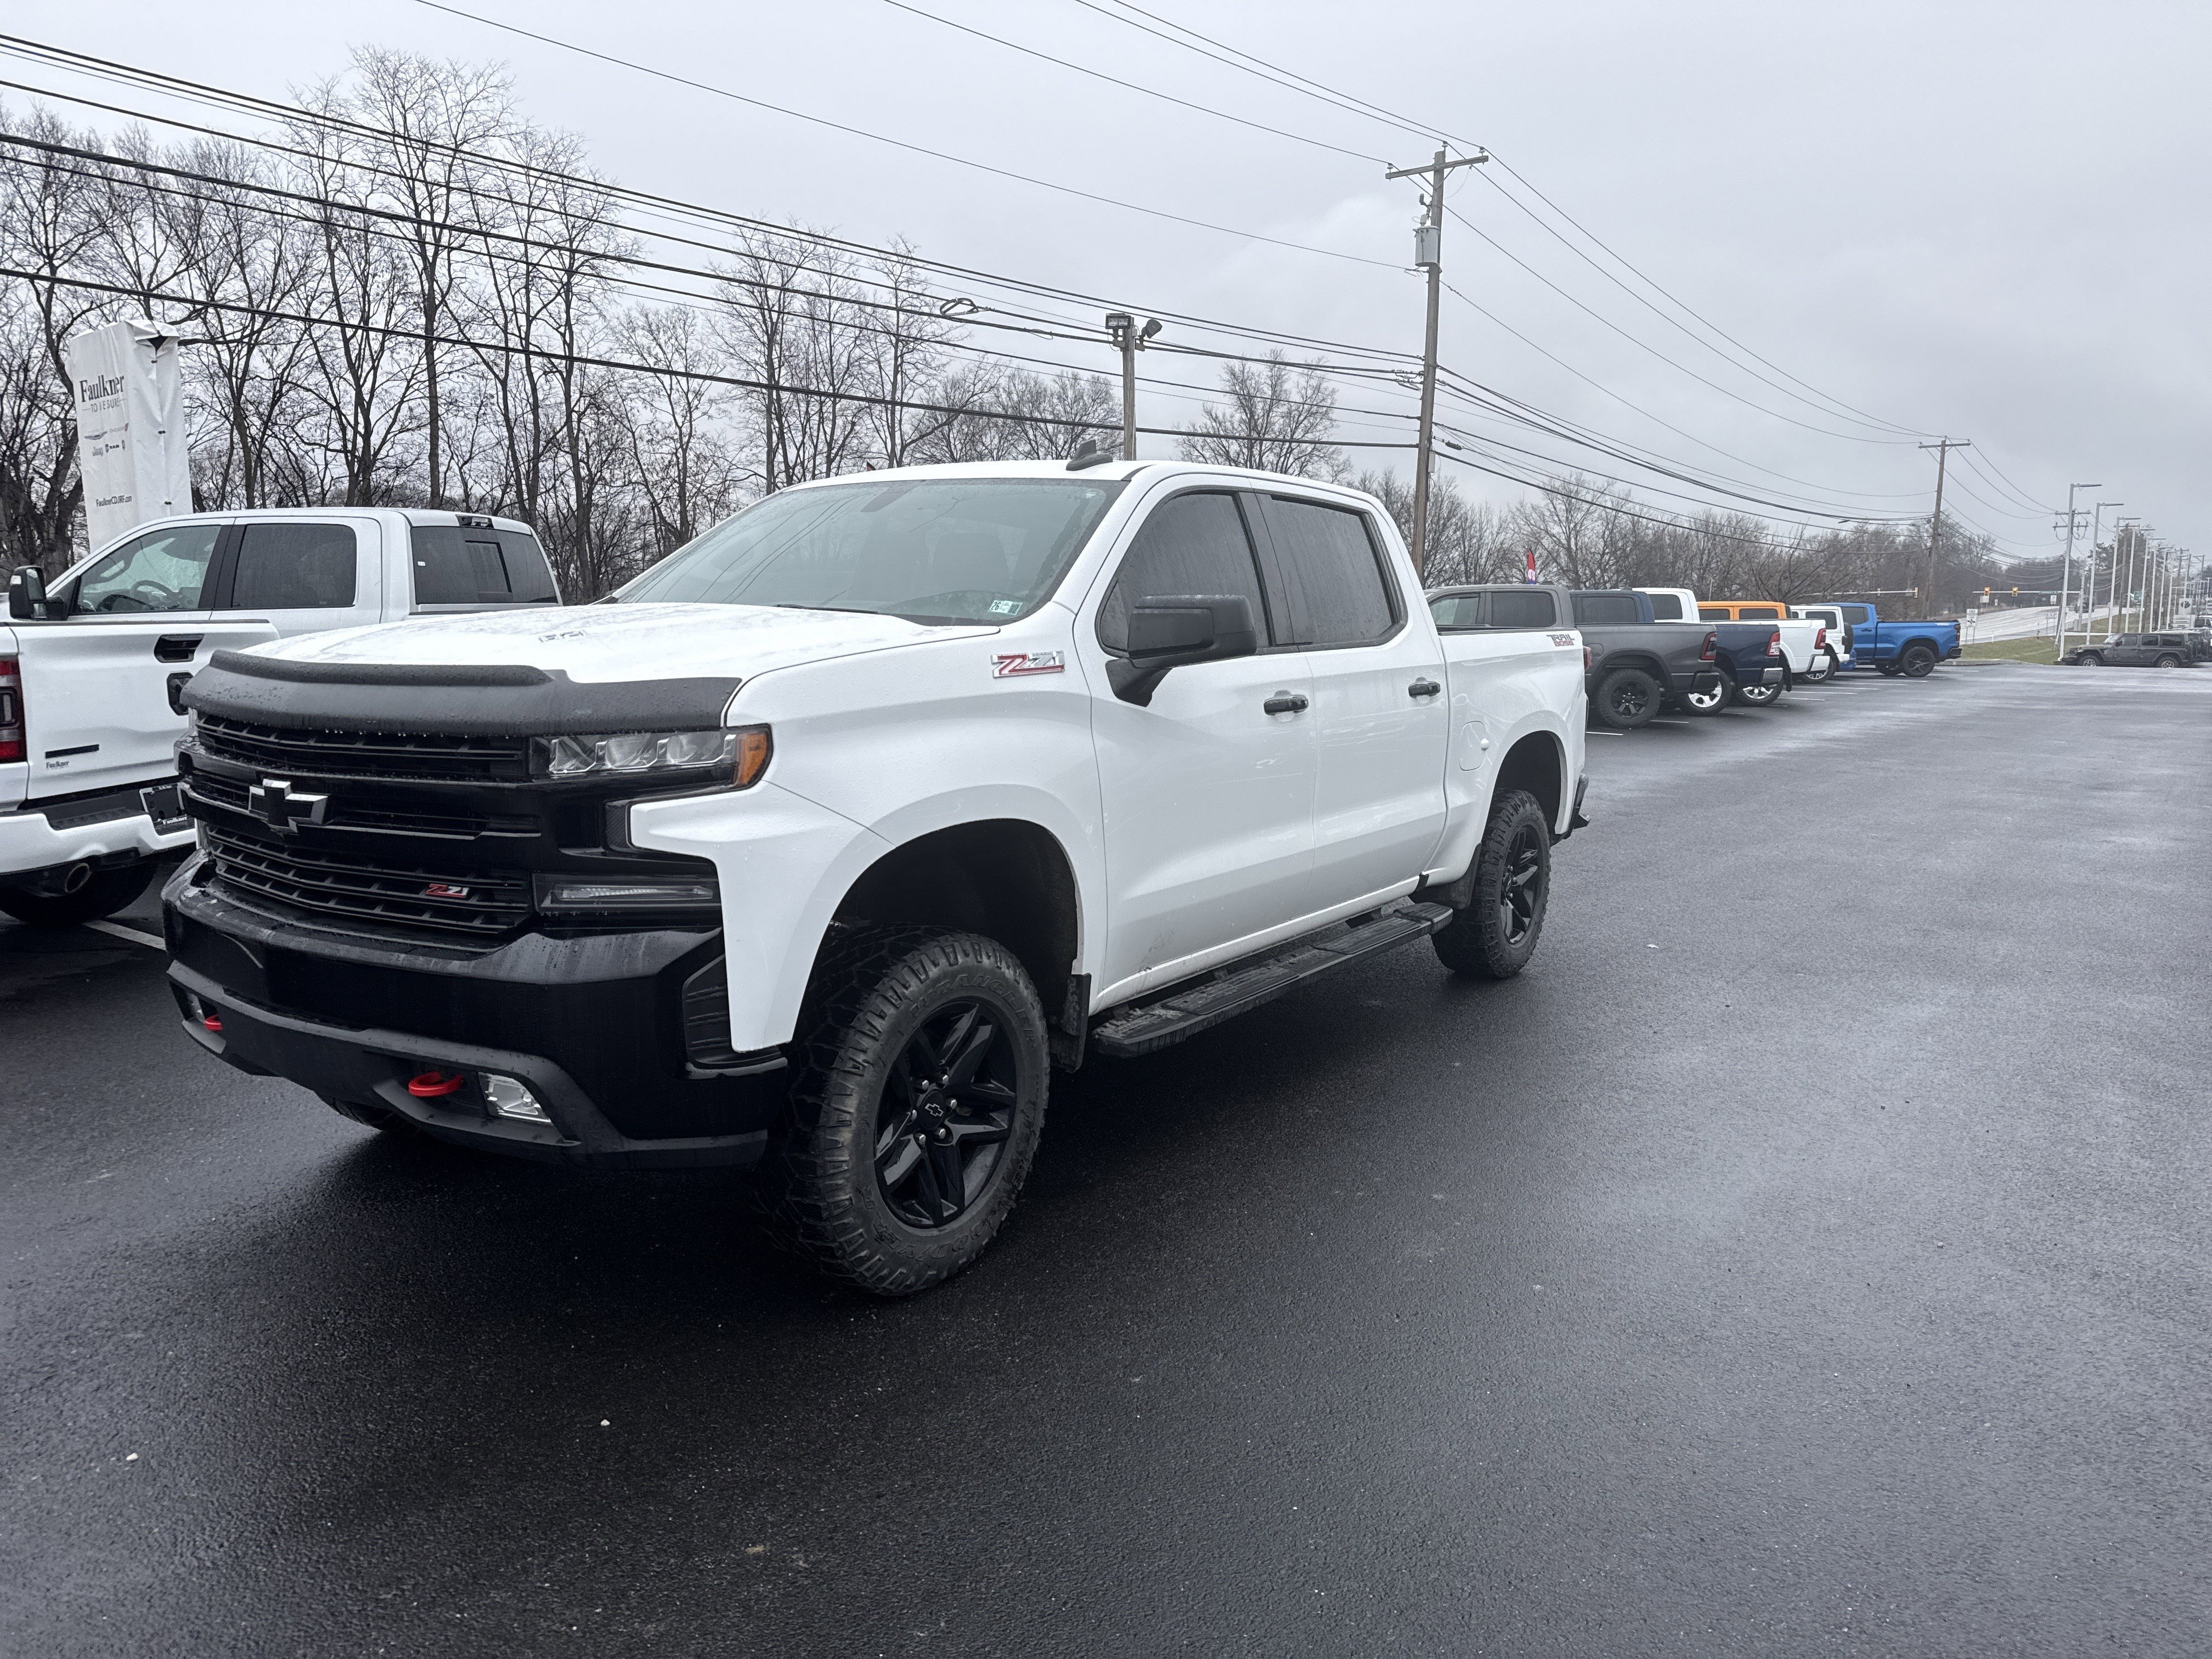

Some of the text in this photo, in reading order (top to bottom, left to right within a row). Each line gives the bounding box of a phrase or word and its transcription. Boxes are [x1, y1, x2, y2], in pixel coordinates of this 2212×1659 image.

[79, 375, 125, 402] Faulkner
[91, 403, 98, 413] TO
[991, 601, 1001, 611] 26
[990, 651, 1065, 679] Z71
[426, 883, 469, 899] Z71
